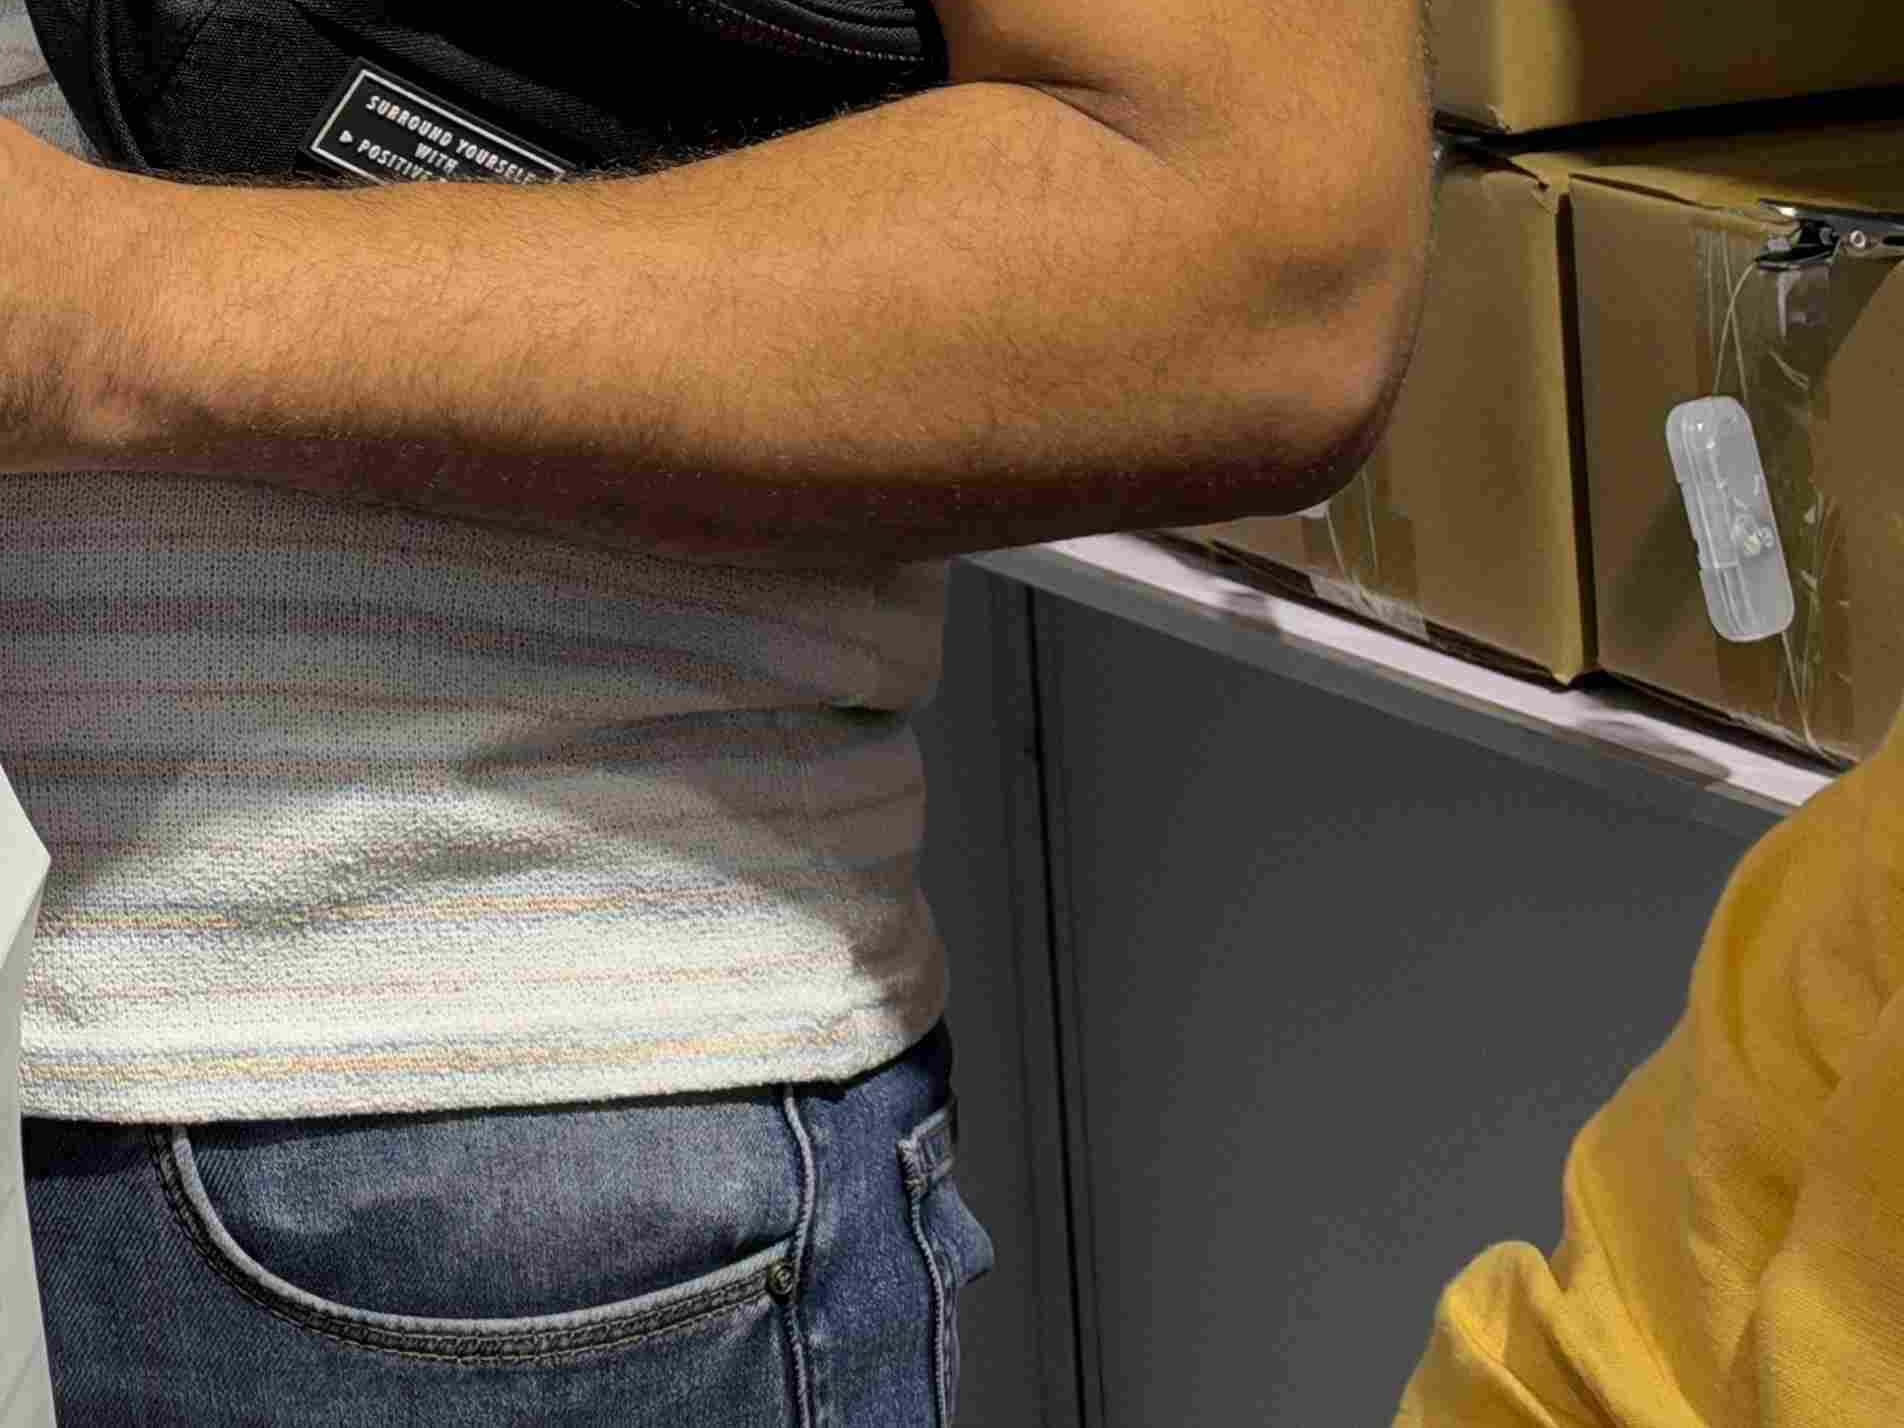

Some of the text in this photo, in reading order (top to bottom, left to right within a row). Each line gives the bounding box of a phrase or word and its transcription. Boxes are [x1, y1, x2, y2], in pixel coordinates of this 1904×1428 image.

[365, 95, 535, 184] SURROUND YOURSELF
[414, 142, 459, 174] WITH
